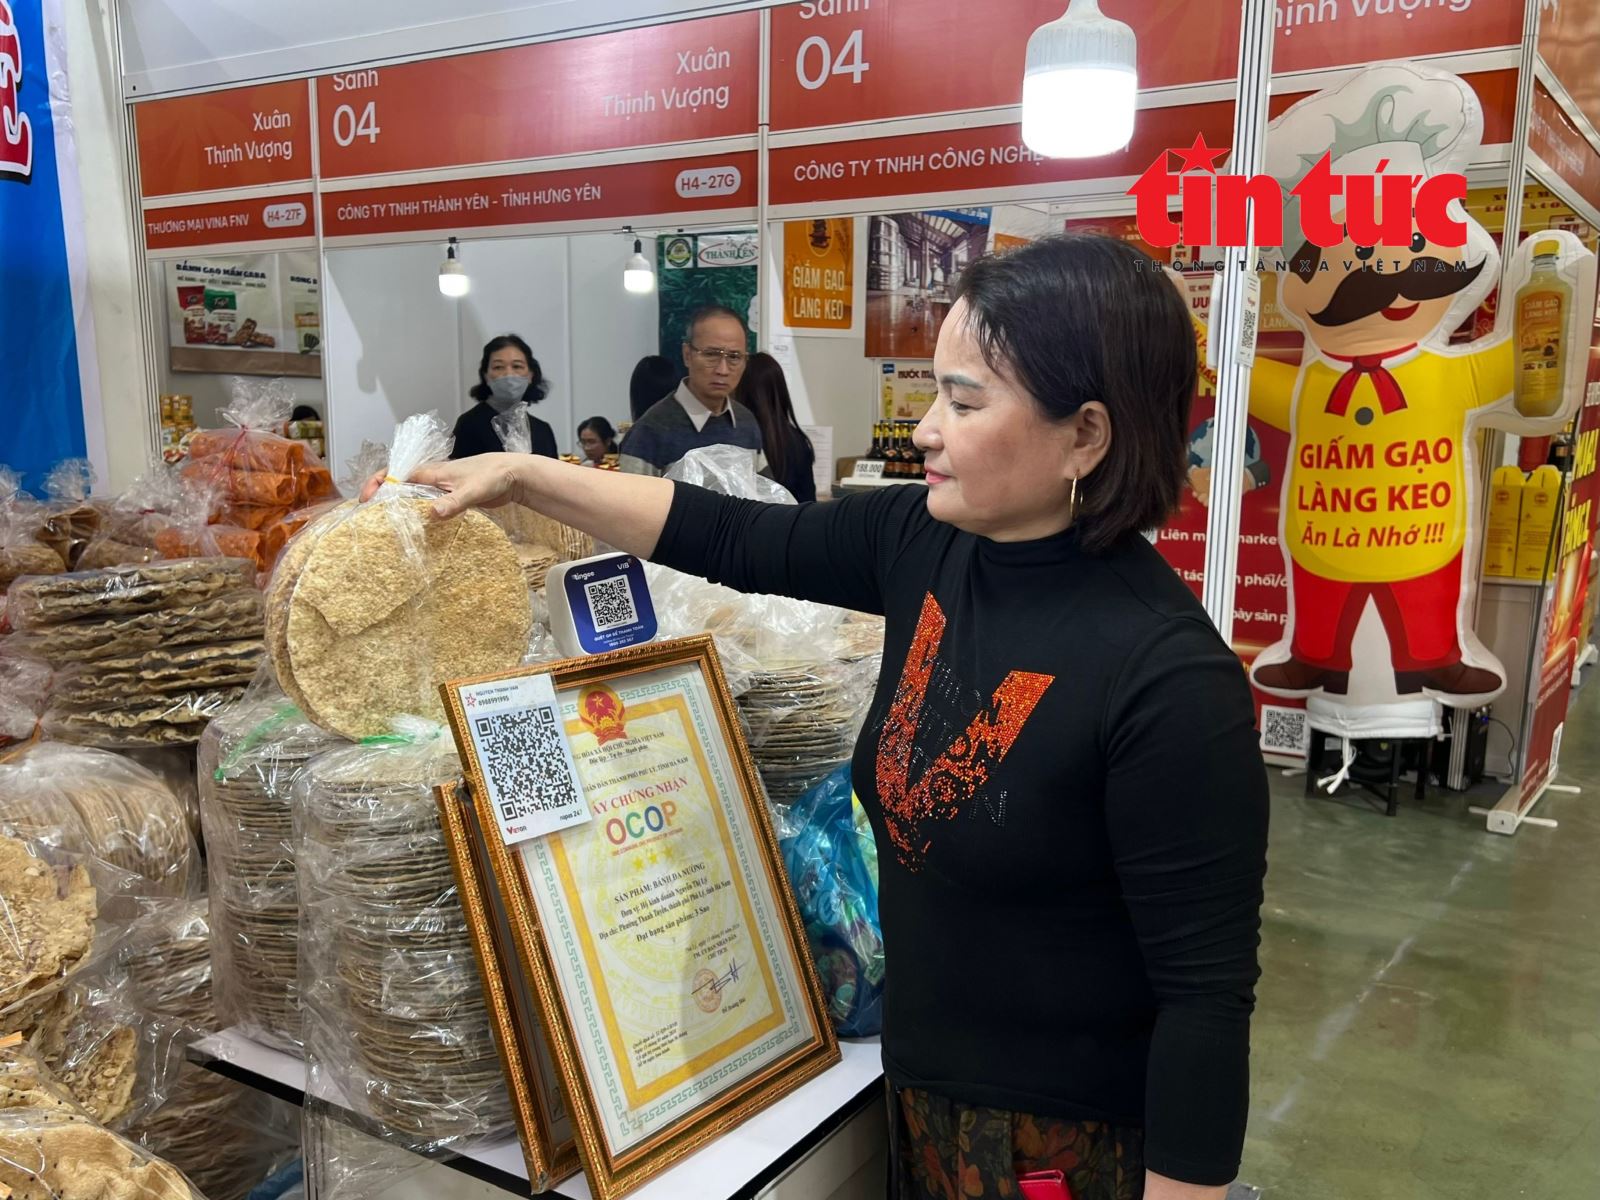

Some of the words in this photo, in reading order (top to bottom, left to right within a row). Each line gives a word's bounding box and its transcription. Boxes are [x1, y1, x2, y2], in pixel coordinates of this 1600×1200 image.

[675, 46, 730, 74] Xuân
[796, 29, 870, 90] 04
[601, 90, 656, 121] Thịnh
[661, 85, 730, 113] Vượng
[252, 110, 291, 131] Xuân
[333, 101, 381, 147] 04
[204, 145, 243, 168] Thịnh
[244, 140, 292, 163] Vượng
[793, 160, 844, 182] CÔNG
[848, 159, 871, 178] TY
[875, 154, 925, 175] TNHH
[928, 146, 985, 171] CÔNG
[680, 172, 736, 193] H4-27G
[266, 208, 303, 222] H4-27F
[337, 203, 370, 221] CÔNG
[371, 203, 386, 219] TY
[388, 200, 420, 217] TNHH
[422, 195, 462, 214] THÀNH
[464, 192, 490, 211] YÊN
[501, 187, 532, 208] TỈNH
[533, 187, 572, 206] HƯNG
[574, 182, 602, 203] YÊN
[148, 221, 186, 235] THƯƠNG
[187, 219, 205, 233] MẠI
[203, 217, 229, 230] VINA
[229, 213, 250, 227] FNV
[792, 258, 821, 289] GIẤM
[823, 268, 846, 295] GẠO
[792, 292, 822, 321] LÀNG
[823, 298, 845, 321] KEO
[1299, 434, 1375, 470] GIẤM
[1383, 436, 1454, 475] GẠO
[1297, 480, 1378, 513] LÀNG
[1387, 480, 1452, 512] KEO
[1160, 528, 1189, 541] Liên
[1300, 520, 1328, 546] Ăn
[1332, 526, 1361, 548] Là
[1366, 523, 1422, 548] Nhớ
[1422, 521, 1446, 544] !!!
[616, 561, 630, 571] VIB
[1244, 573, 1288, 588] phối/
[1255, 607, 1278, 622] sản
[609, 784, 654, 808] CHỨNG
[655, 776, 688, 796] NHẬN
[605, 801, 677, 846] OCOP
[651, 873, 671, 888] BÁNH
